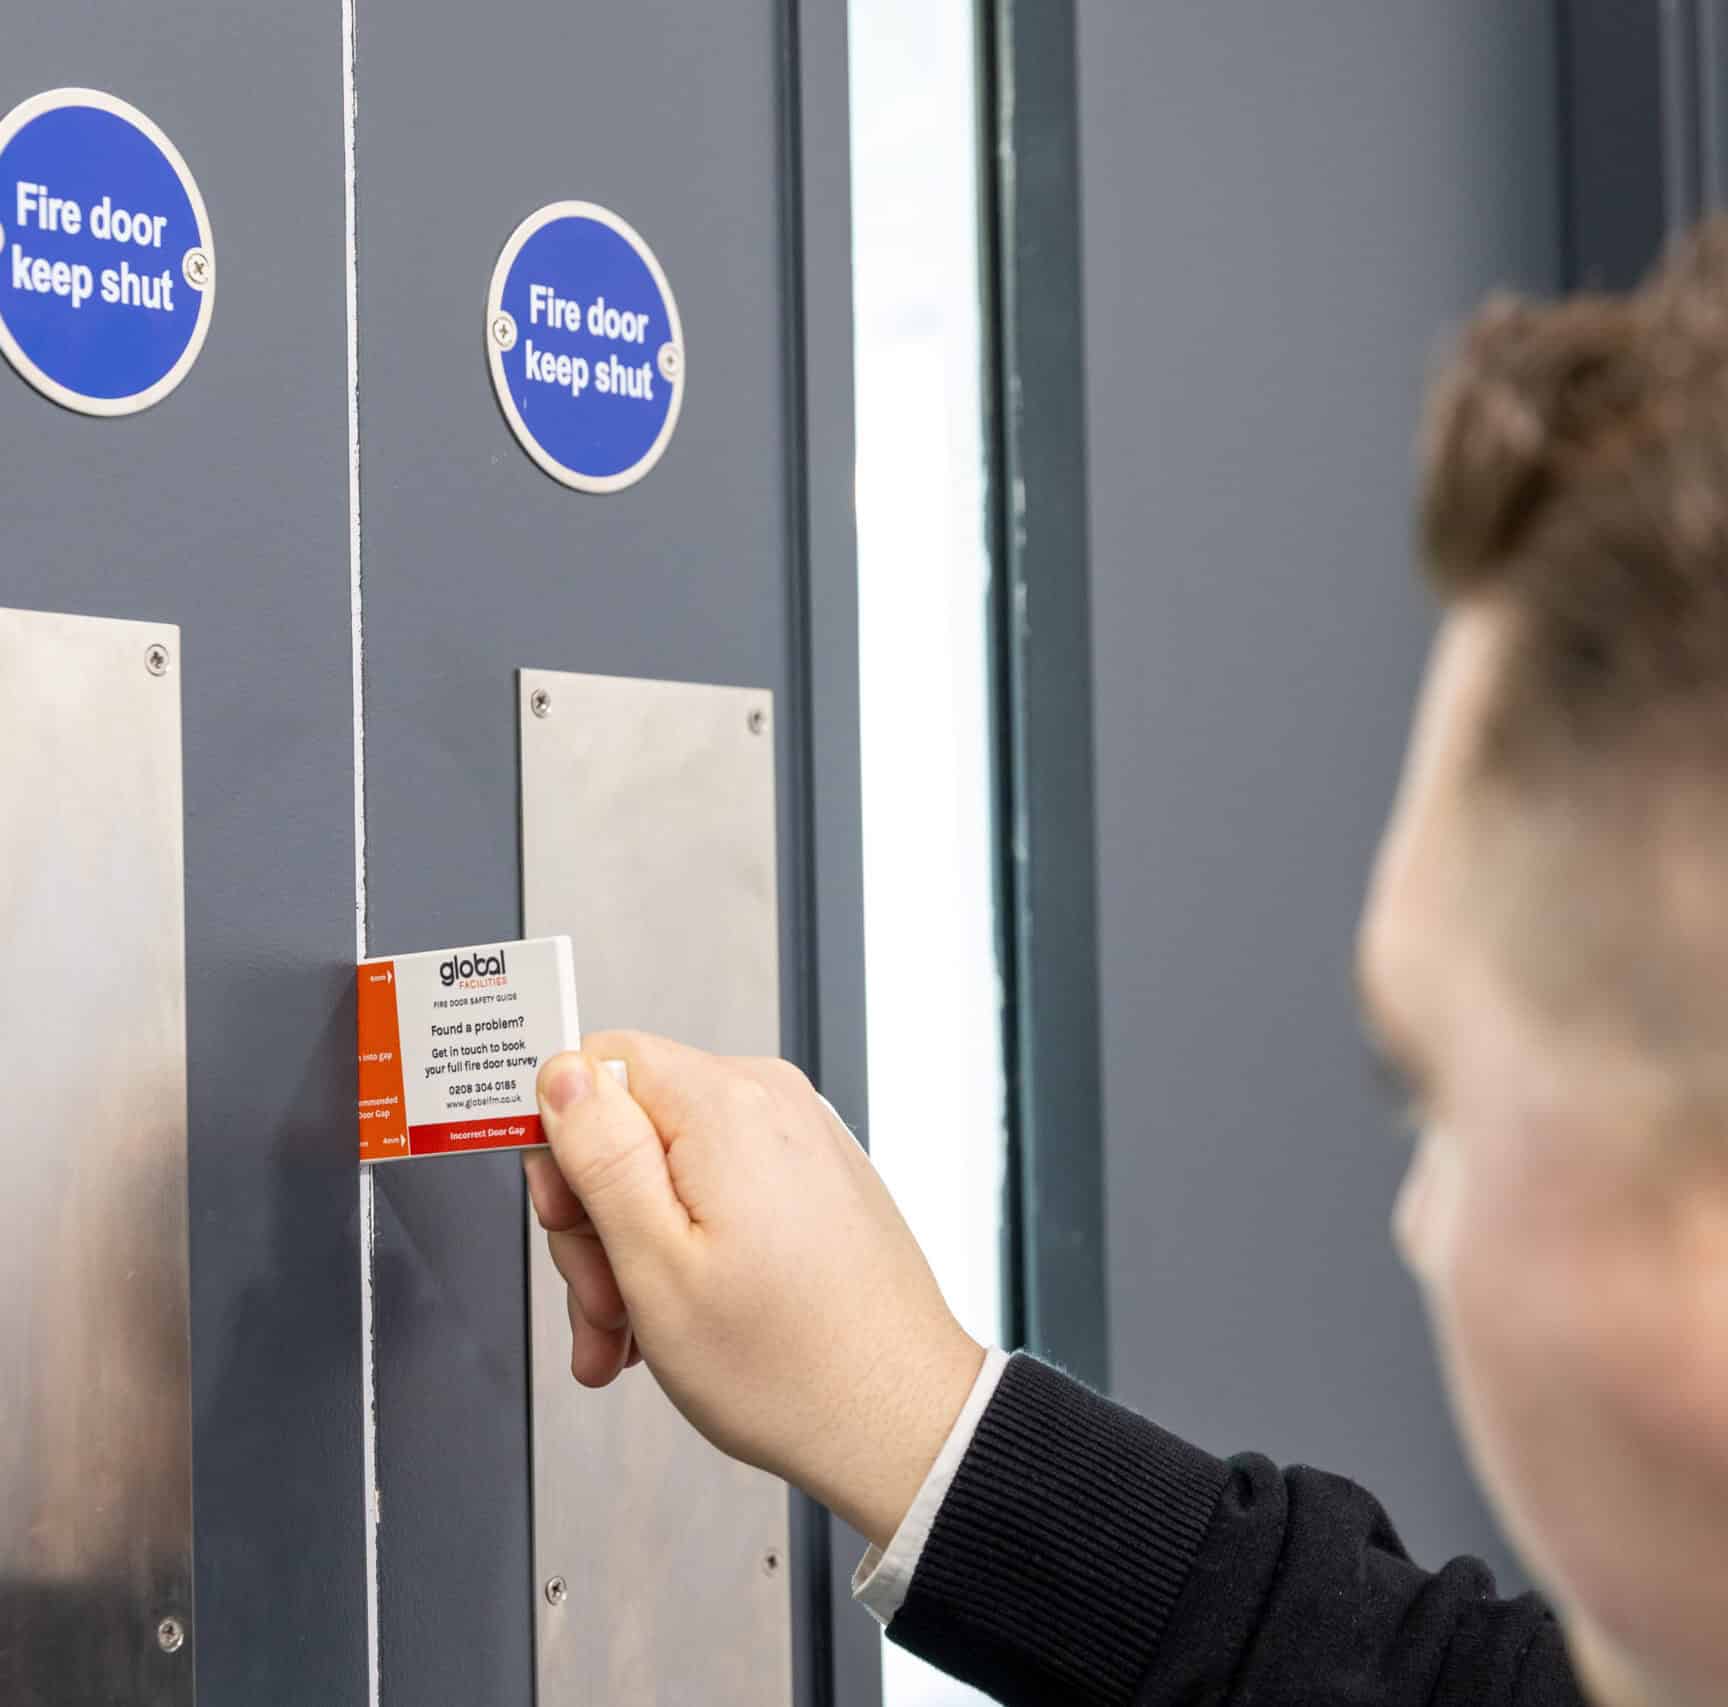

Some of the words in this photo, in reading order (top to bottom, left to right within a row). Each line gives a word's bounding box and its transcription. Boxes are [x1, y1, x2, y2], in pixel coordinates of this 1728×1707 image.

[16, 181, 82, 234] Fire
[89, 196, 168, 248] door
[11, 243, 94, 308] keep
[100, 261, 174, 311] shut
[530, 284, 581, 332] Fire
[587, 296, 649, 344] door
[525, 339, 589, 397] keep
[594, 353, 654, 401] shut
[440, 949, 506, 986] global
[458, 975, 508, 989] FACILITIES
[433, 1000, 448, 1008] FIRE
[449, 997, 468, 1008] DOOR
[470, 994, 494, 1005] SAFETY
[495, 992, 517, 1003] GUIDE
[431, 1022, 463, 1037] Found
[466, 1023, 472, 1033] a
[475, 1016, 525, 1036] problem?
[431, 1047, 449, 1059] Get
[450, 1045, 459, 1057] in
[461, 1043, 488, 1056] touch
[490, 1042, 500, 1053] to
[502, 1040, 526, 1052] book
[425, 1064, 445, 1079] your
[447, 1060, 463, 1073] full
[464, 1059, 481, 1072] fire
[482, 1058, 504, 1070] door
[506, 1056, 538, 1069] survey
[448, 1084, 473, 1096] 0208
[475, 1081, 493, 1093] 304
[495, 1080, 517, 1091] 0185
[375, 1108, 391, 1120] Gap
[449, 1129, 486, 1141] Incorrect
[488, 1126, 507, 1138] Door
[508, 1125, 526, 1137] Gap
